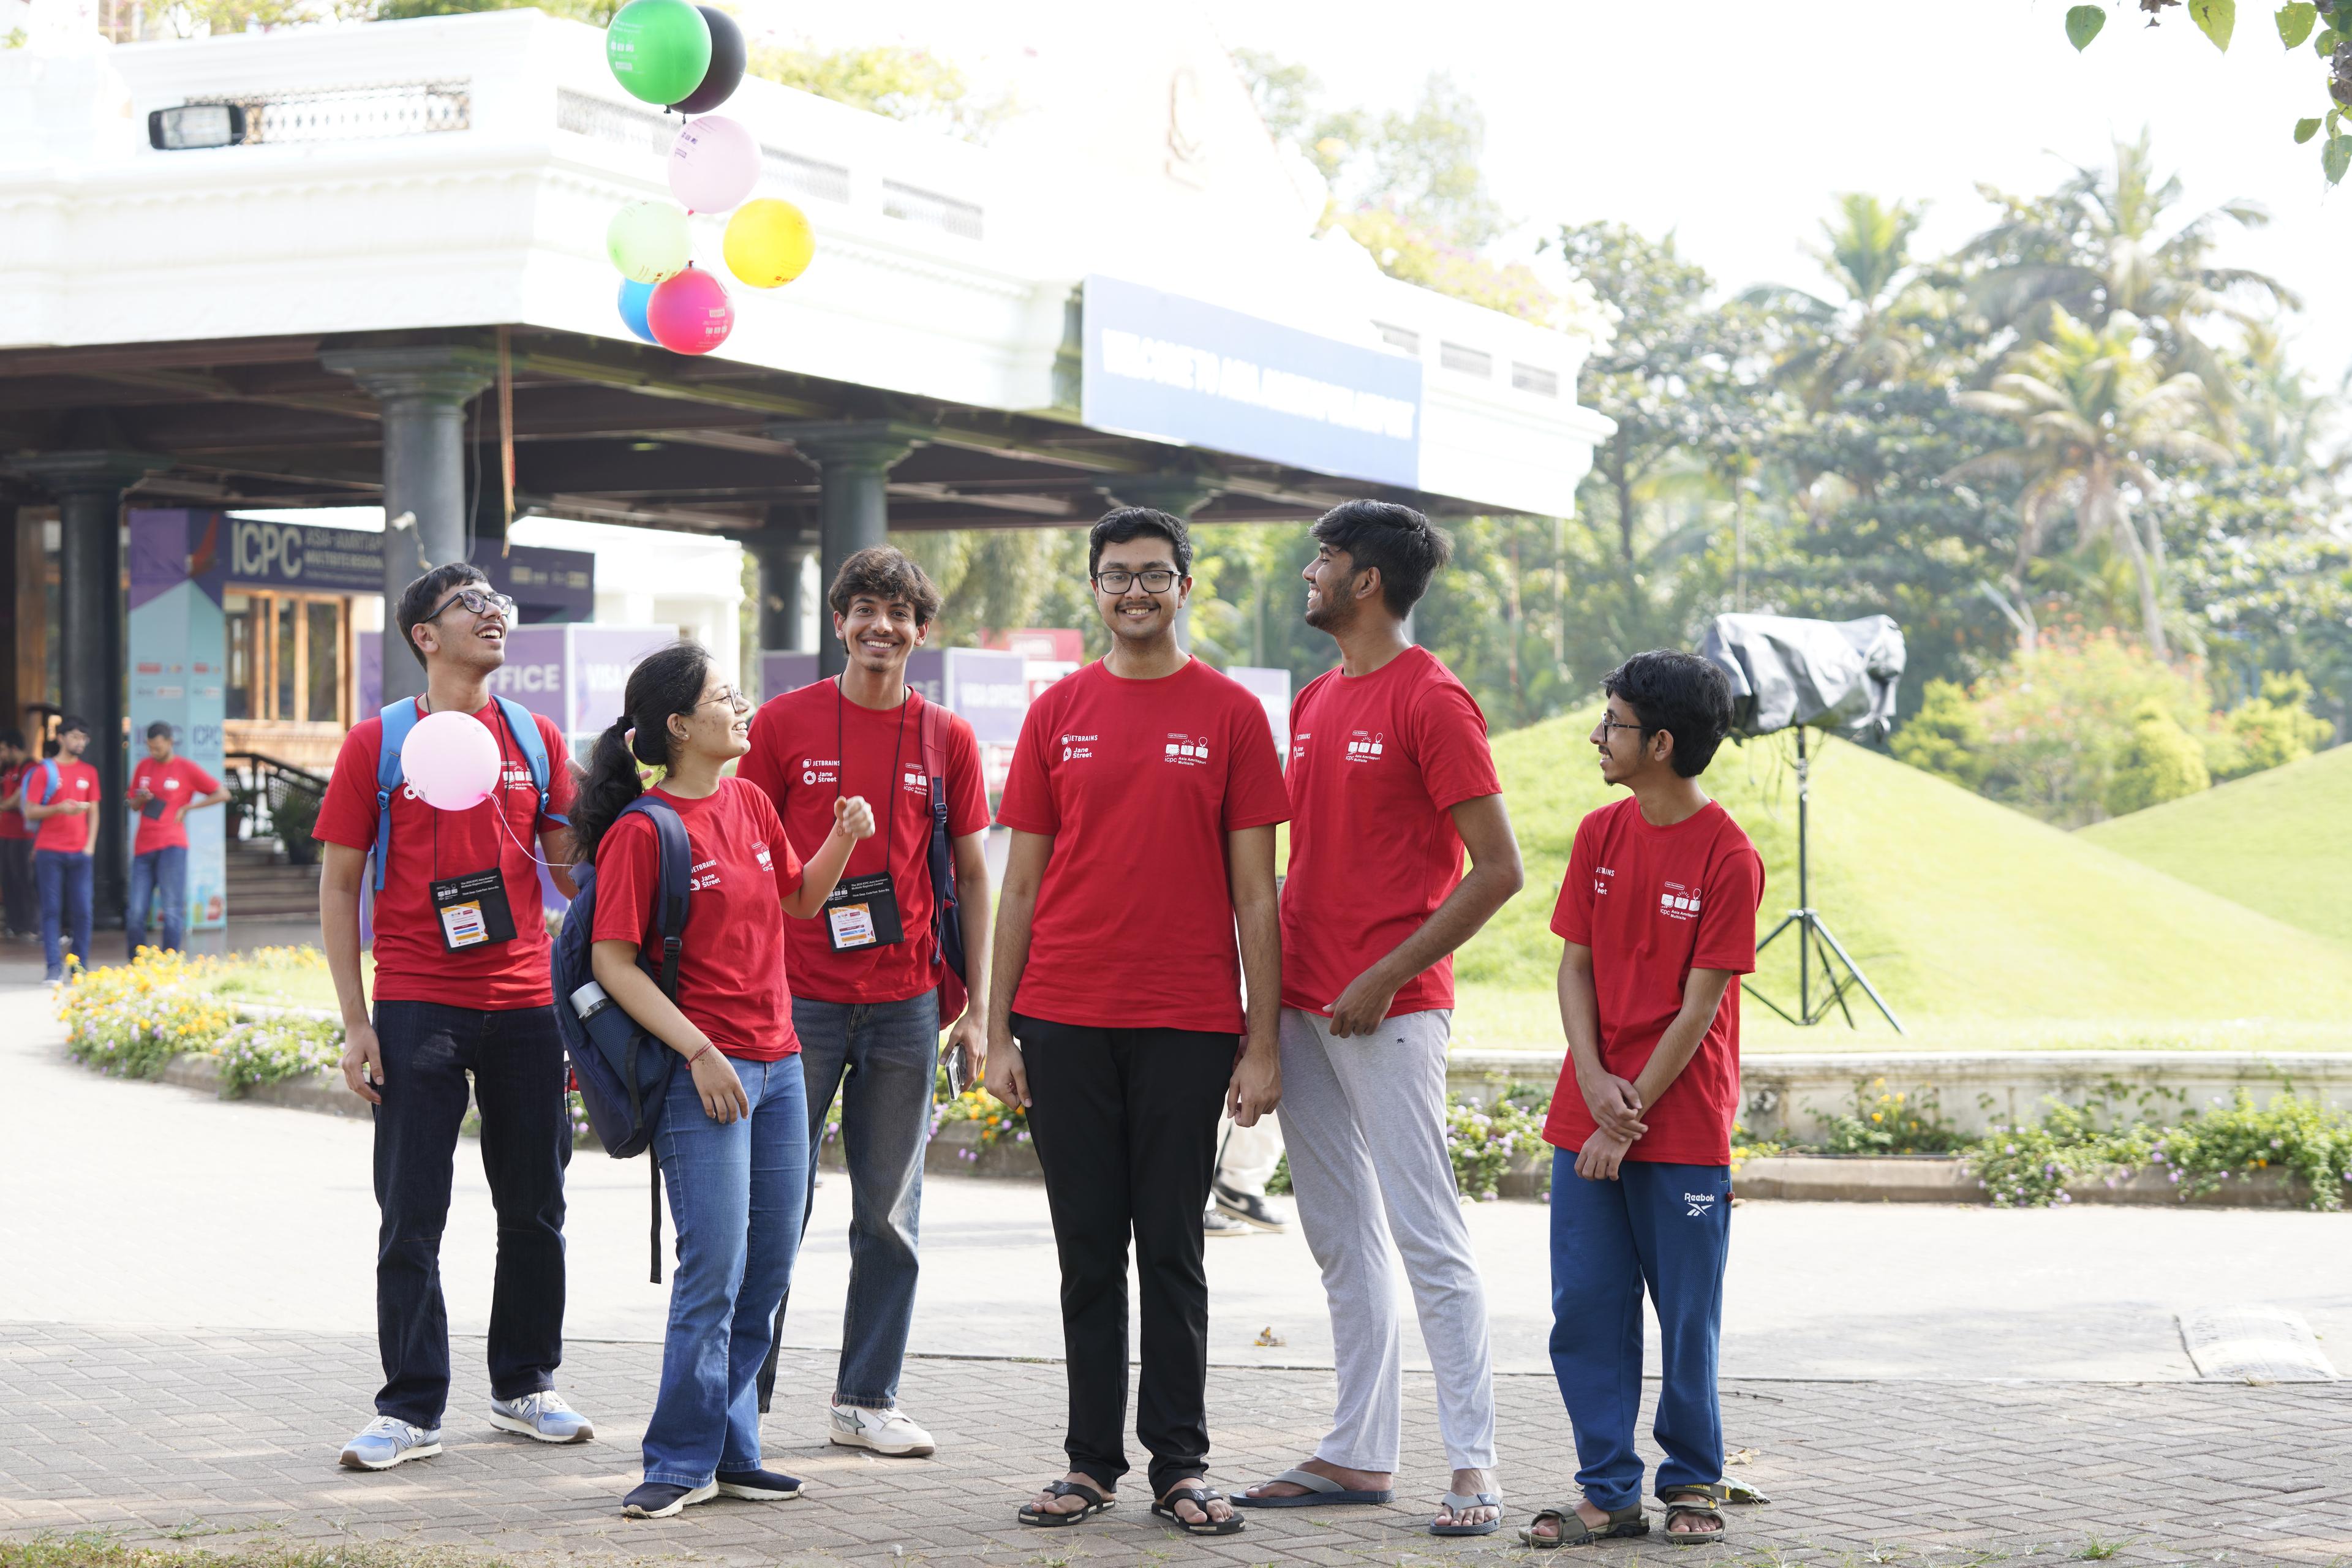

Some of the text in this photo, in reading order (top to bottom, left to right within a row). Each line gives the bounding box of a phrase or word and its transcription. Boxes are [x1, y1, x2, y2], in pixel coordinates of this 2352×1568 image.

[232, 521, 303, 578] ICPC
[691, 859, 717, 873] JETBRAINS
[701, 873, 715, 883] Jane
[702, 878, 721, 888] Street
[1684, 1193, 1714, 1202] Reebok
